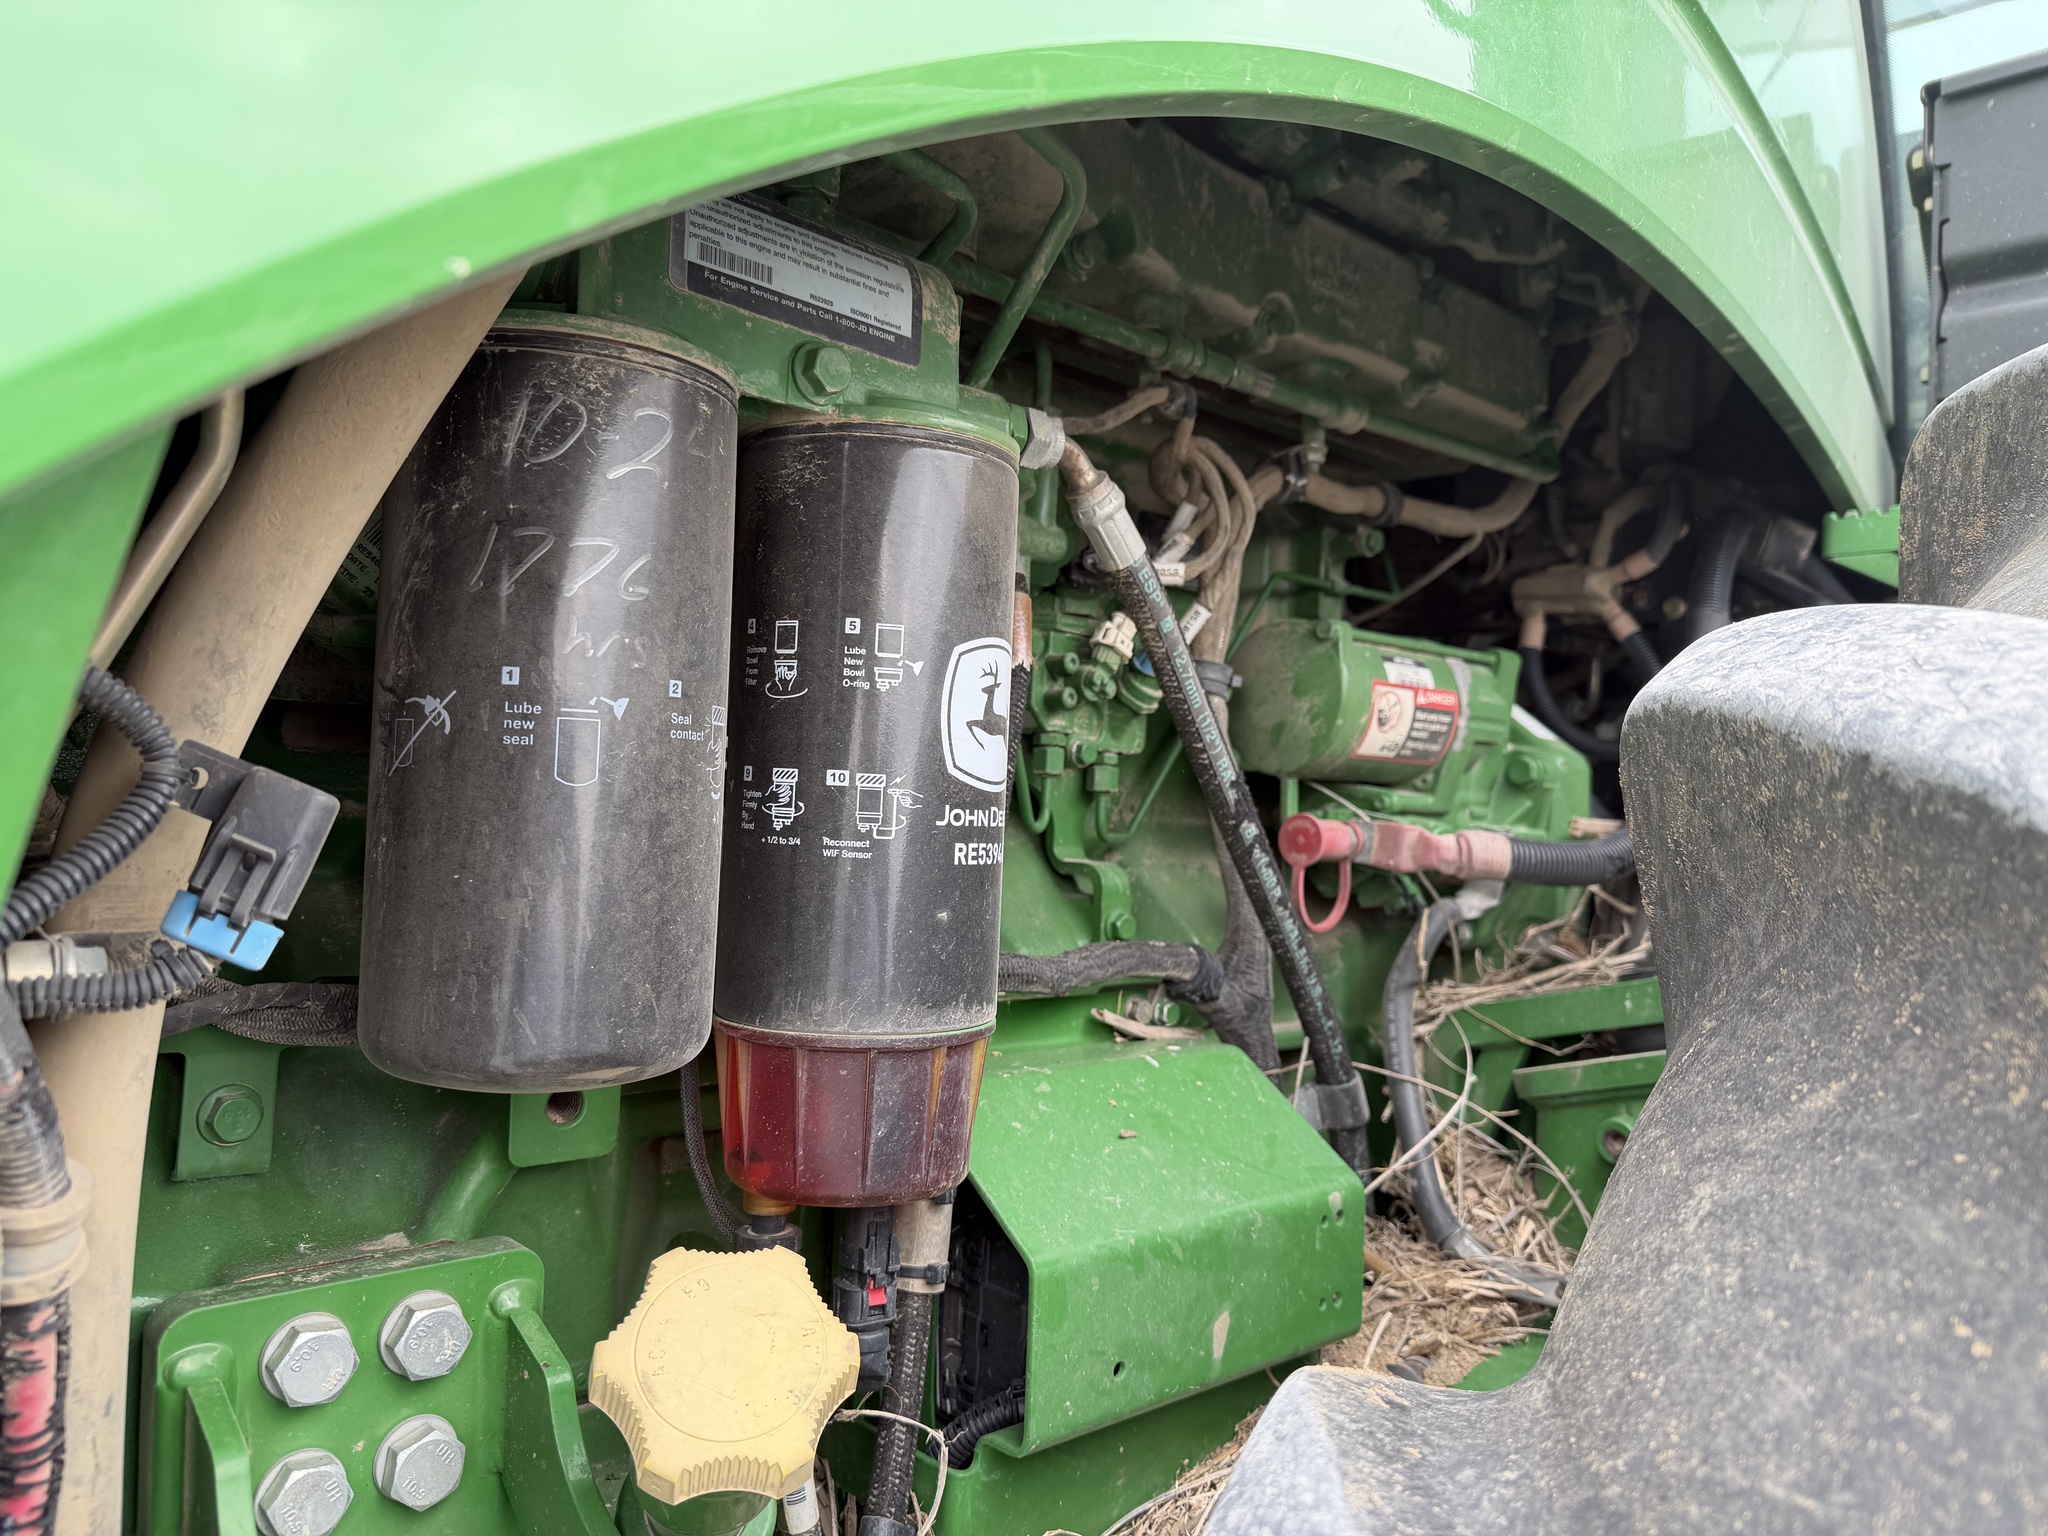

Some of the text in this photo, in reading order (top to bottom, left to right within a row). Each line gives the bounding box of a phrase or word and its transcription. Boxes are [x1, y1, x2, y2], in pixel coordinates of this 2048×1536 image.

[706, 205, 752, 226] unauthorized
[752, 222, 792, 242] adjustments
[793, 236, 801, 244] to
[801, 238, 814, 250] this
[814, 245, 837, 259] engine.
[721, 201, 733, 210] will
[734, 207, 745, 215] not
[746, 211, 765, 223] apply
[766, 217, 773, 226] to
[774, 222, 796, 235] engine
[798, 230, 810, 240] and
[810, 235, 840, 251] drivetrain
[840, 246, 863, 260] failures
[688, 231, 723, 248] penalties.
[690, 208, 904, 294] Unauthorized adjustments are in violation of the emission regulations
[689, 220, 890, 298] applicable to this engine and may result in substantial fines and
[704, 270, 896, 343] For Engine Service and Parts Call 1-800-JD ENGINE
[810, 293, 834, 308] R523929
[850, 307, 902, 332] ISO9001 Registered
[355, 543, 382, 567] RE546
[746, 646, 768, 654] Remove
[844, 646, 866, 656] Lube
[746, 656, 758, 664] Bowl
[844, 657, 864, 666] New
[746, 668, 758, 676] From
[843, 668, 866, 678] Bowl
[1172, 646, 1202, 710] 12.7mm
[842, 678, 870, 690] O-ring
[504, 701, 542, 716] Lube
[503, 718, 535, 731] new
[670, 712, 692, 726] Seal
[502, 732, 534, 746] seal
[670, 729, 705, 742] contact
[829, 772, 846, 784] 10
[742, 790, 762, 800] Tighten
[742, 800, 758, 811] Firmly
[742, 810, 749, 822] By
[936, 804, 989, 827] JOHN
[741, 820, 755, 830] Hand
[766, 836, 778, 846] 1/2
[779, 836, 788, 846] to
[788, 837, 802, 847] 3/4
[822, 837, 870, 849] Reconnect
[822, 849, 872, 860] WIF Sensor
